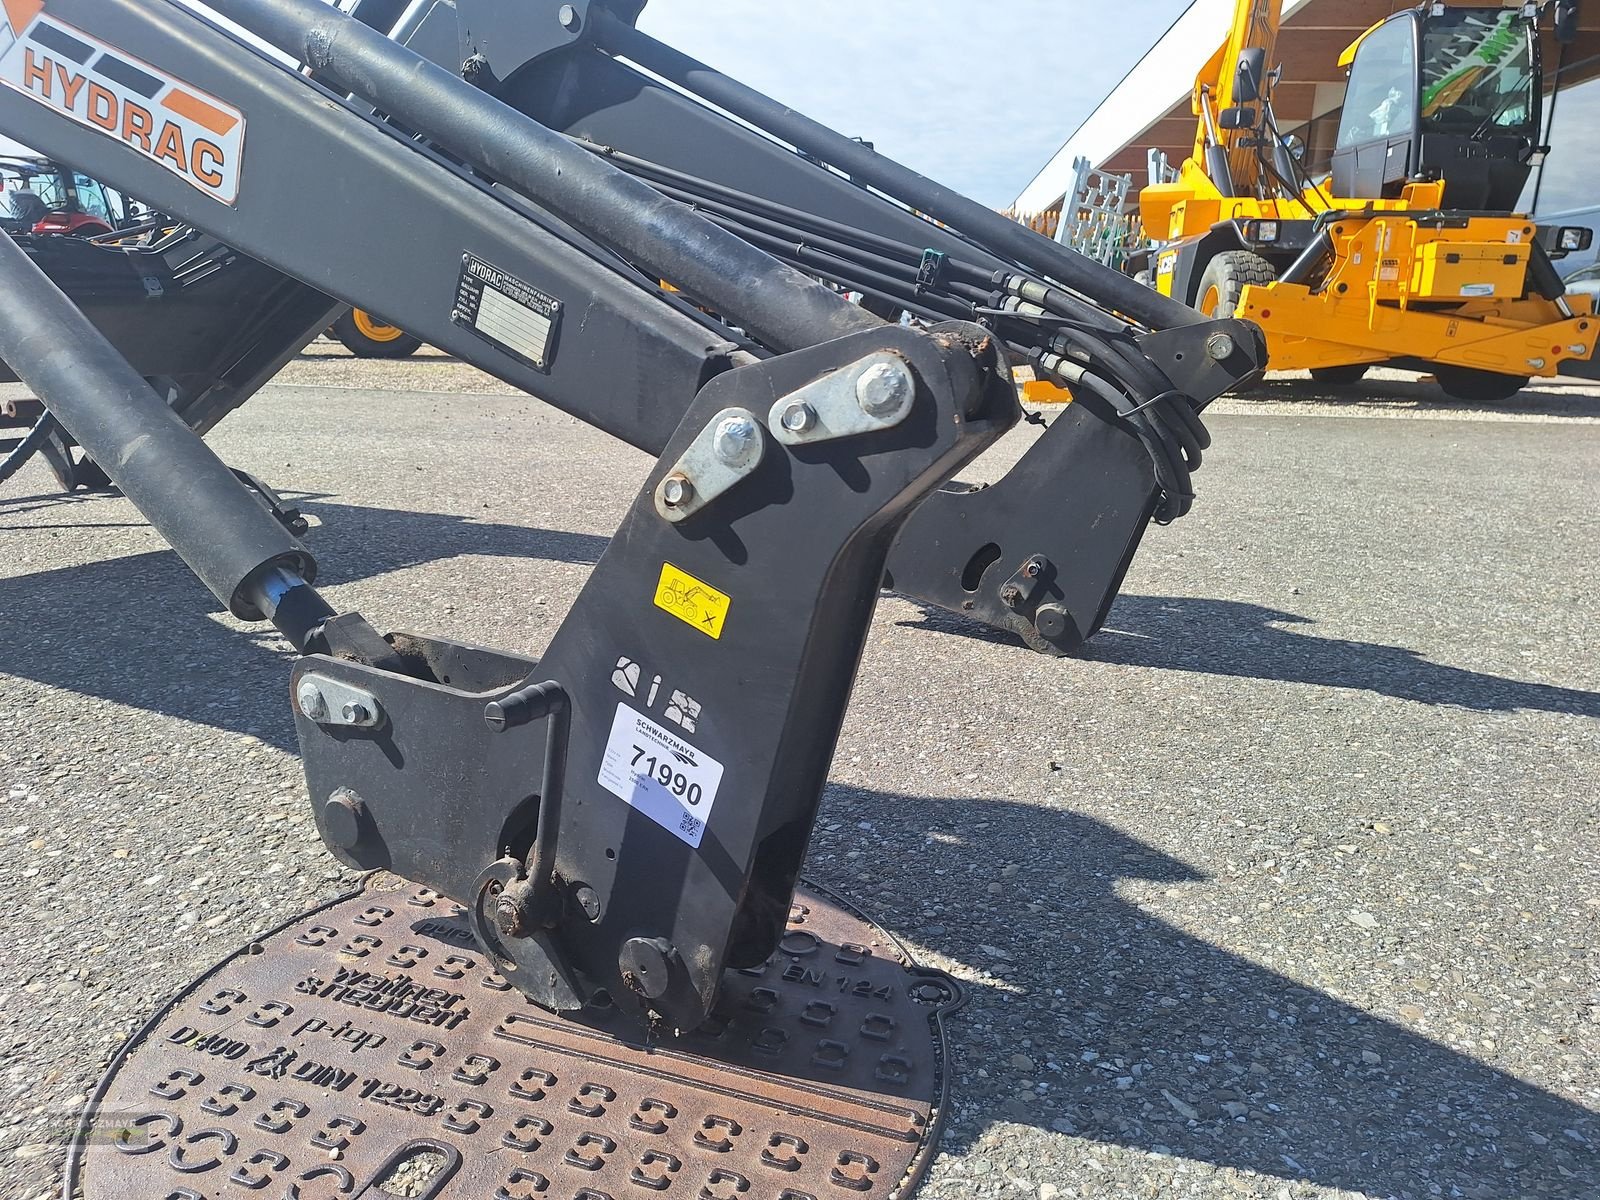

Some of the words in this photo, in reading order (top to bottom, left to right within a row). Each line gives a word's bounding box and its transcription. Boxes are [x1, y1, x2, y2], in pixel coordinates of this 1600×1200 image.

[24, 46, 225, 188] HYDRAC
[470, 259, 502, 287] HYDRAC
[504, 274, 553, 304] MASCHINENFABRIK
[635, 727, 671, 751] LANDTECHNIK
[636, 718, 695, 759] SCHWARZMAYR
[630, 744, 702, 806] 71990
[294, 976, 324, 995] &
[333, 966, 465, 1009] wallner
[782, 964, 825, 987] EN
[836, 976, 892, 1002] 124
[291, 1060, 358, 1091] DIN
[358, 1078, 446, 1116] 1229
